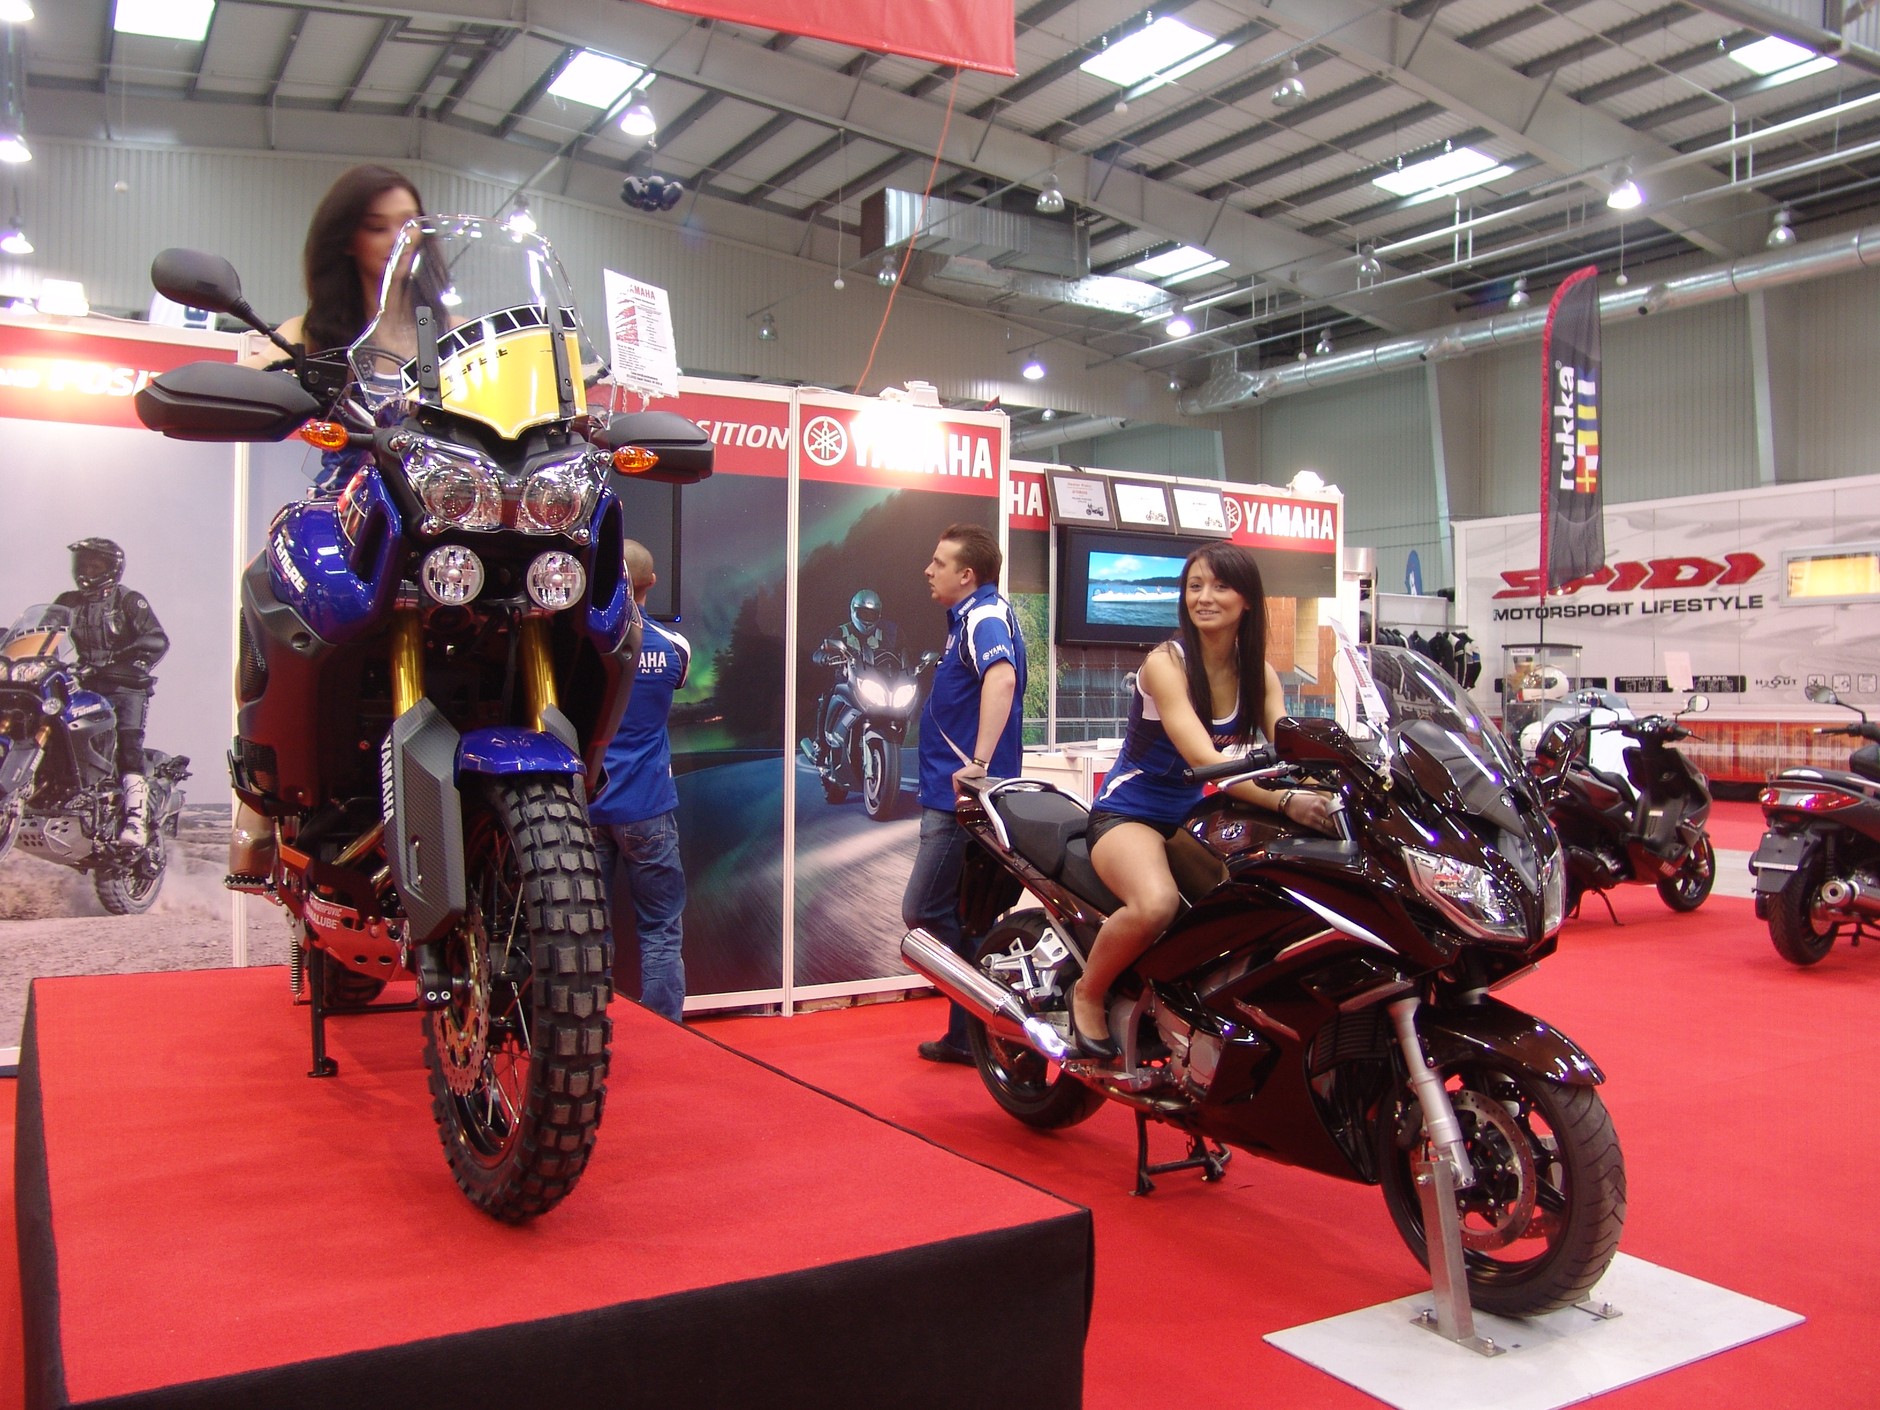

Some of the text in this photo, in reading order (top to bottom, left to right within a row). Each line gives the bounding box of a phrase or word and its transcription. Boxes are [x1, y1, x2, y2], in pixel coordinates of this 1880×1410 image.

[47, 359, 161, 396] POSI
[686, 418, 789, 450] SITION
[1553, 366, 1575, 490] rukka
[1242, 500, 1335, 541] YAMAHA
[1492, 594, 1764, 621] MOTORSPORT LIFESTYLE
[380, 733, 396, 825] YAMAHA
